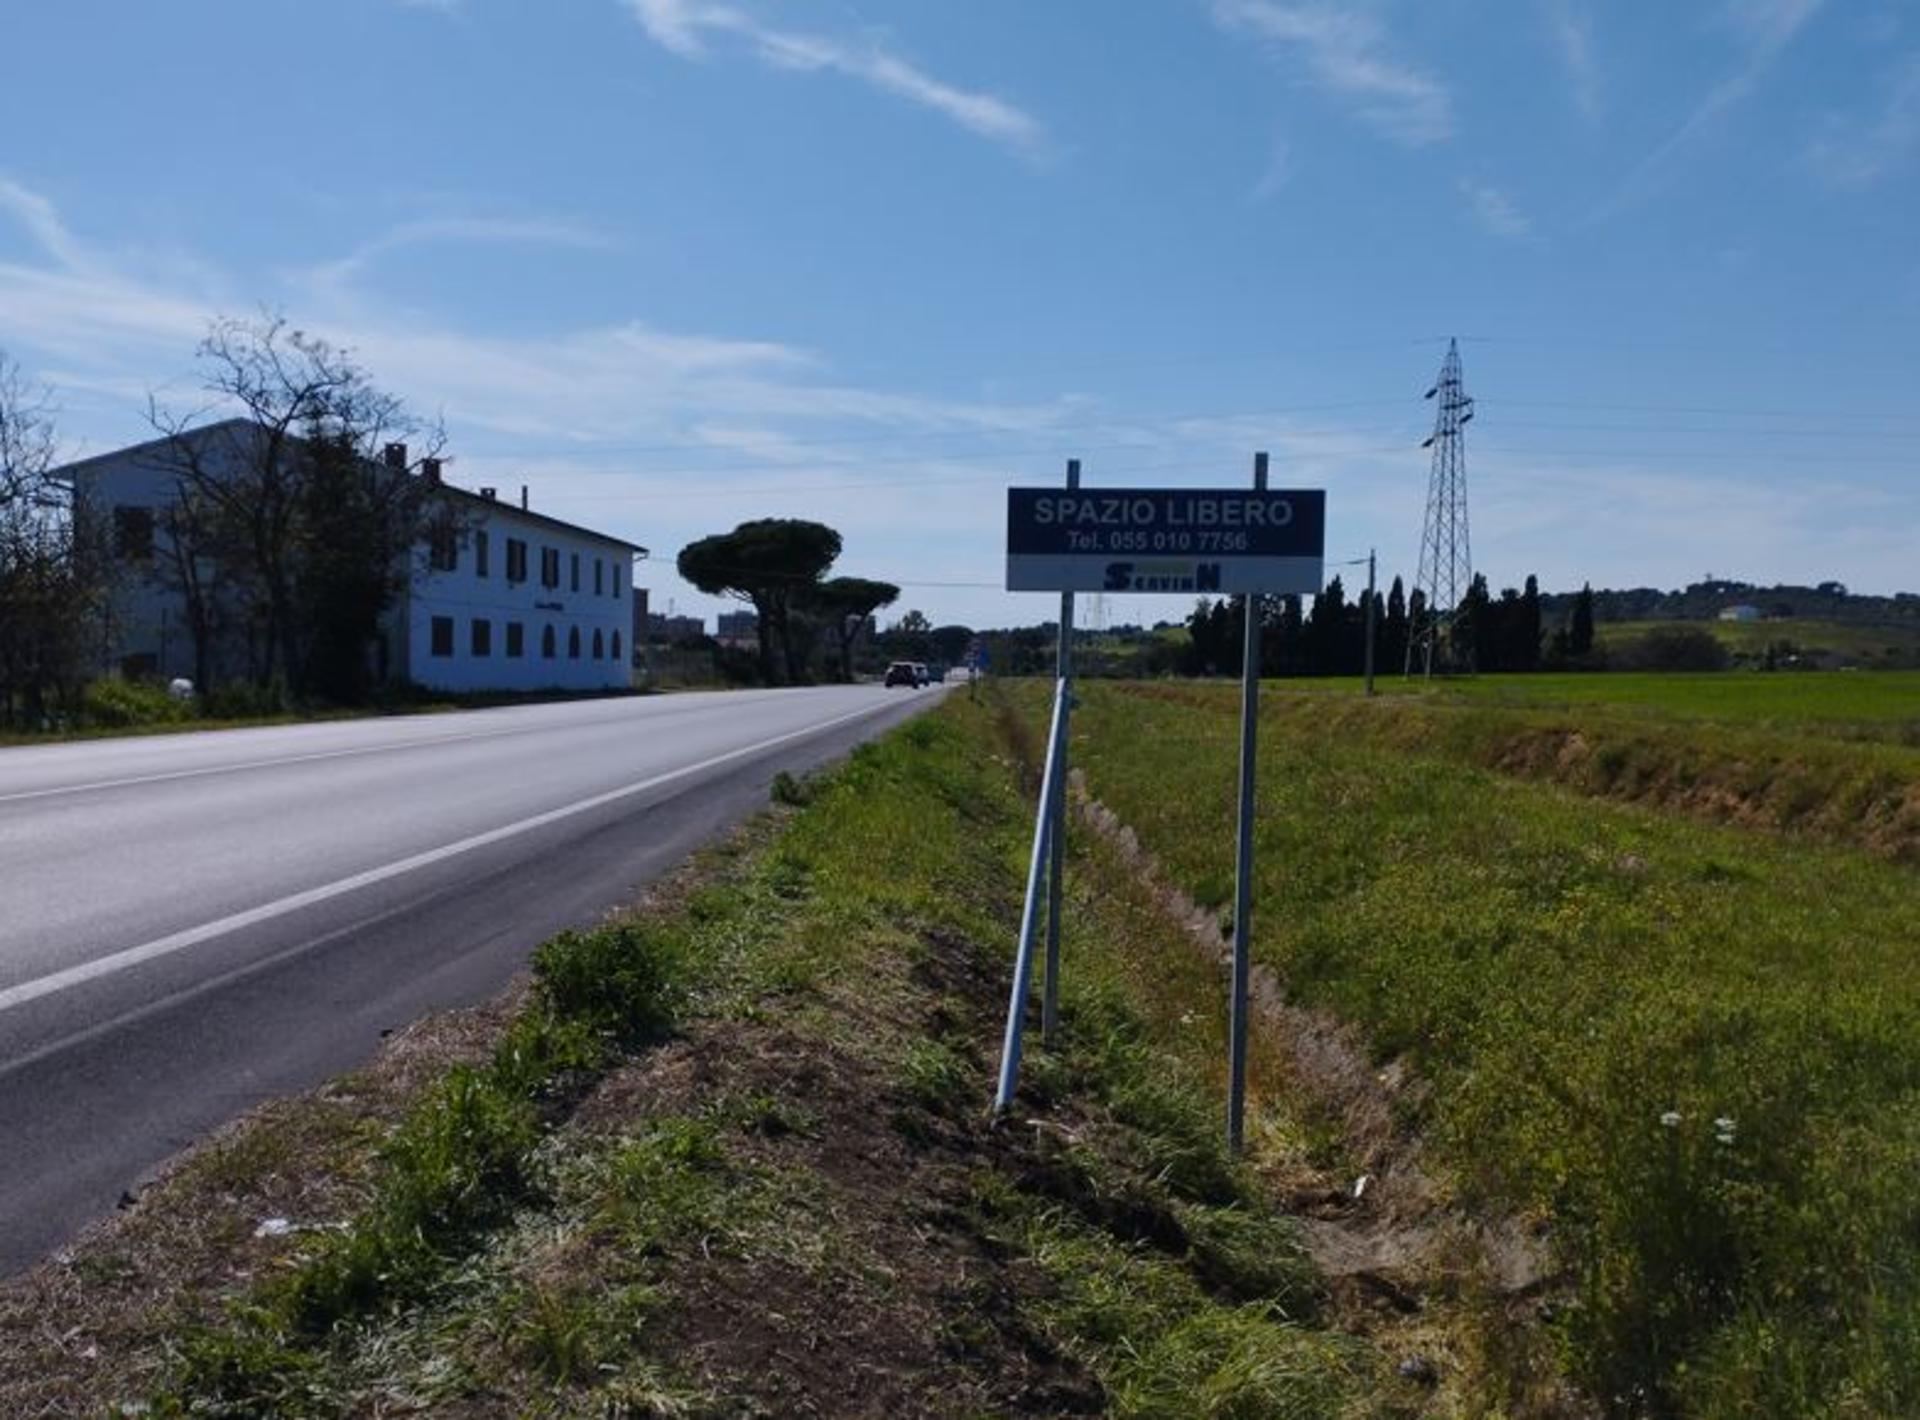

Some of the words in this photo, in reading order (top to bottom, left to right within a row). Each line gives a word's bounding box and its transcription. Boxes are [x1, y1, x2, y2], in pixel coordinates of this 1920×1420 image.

[1034, 498, 1156, 524] SPAZIO
[1166, 499, 1294, 526] LIBERO
[1068, 531, 1103, 550] Tel.
[1109, 532, 1147, 550] 055
[1154, 532, 1191, 550] 010
[1199, 532, 1247, 551] 7756
